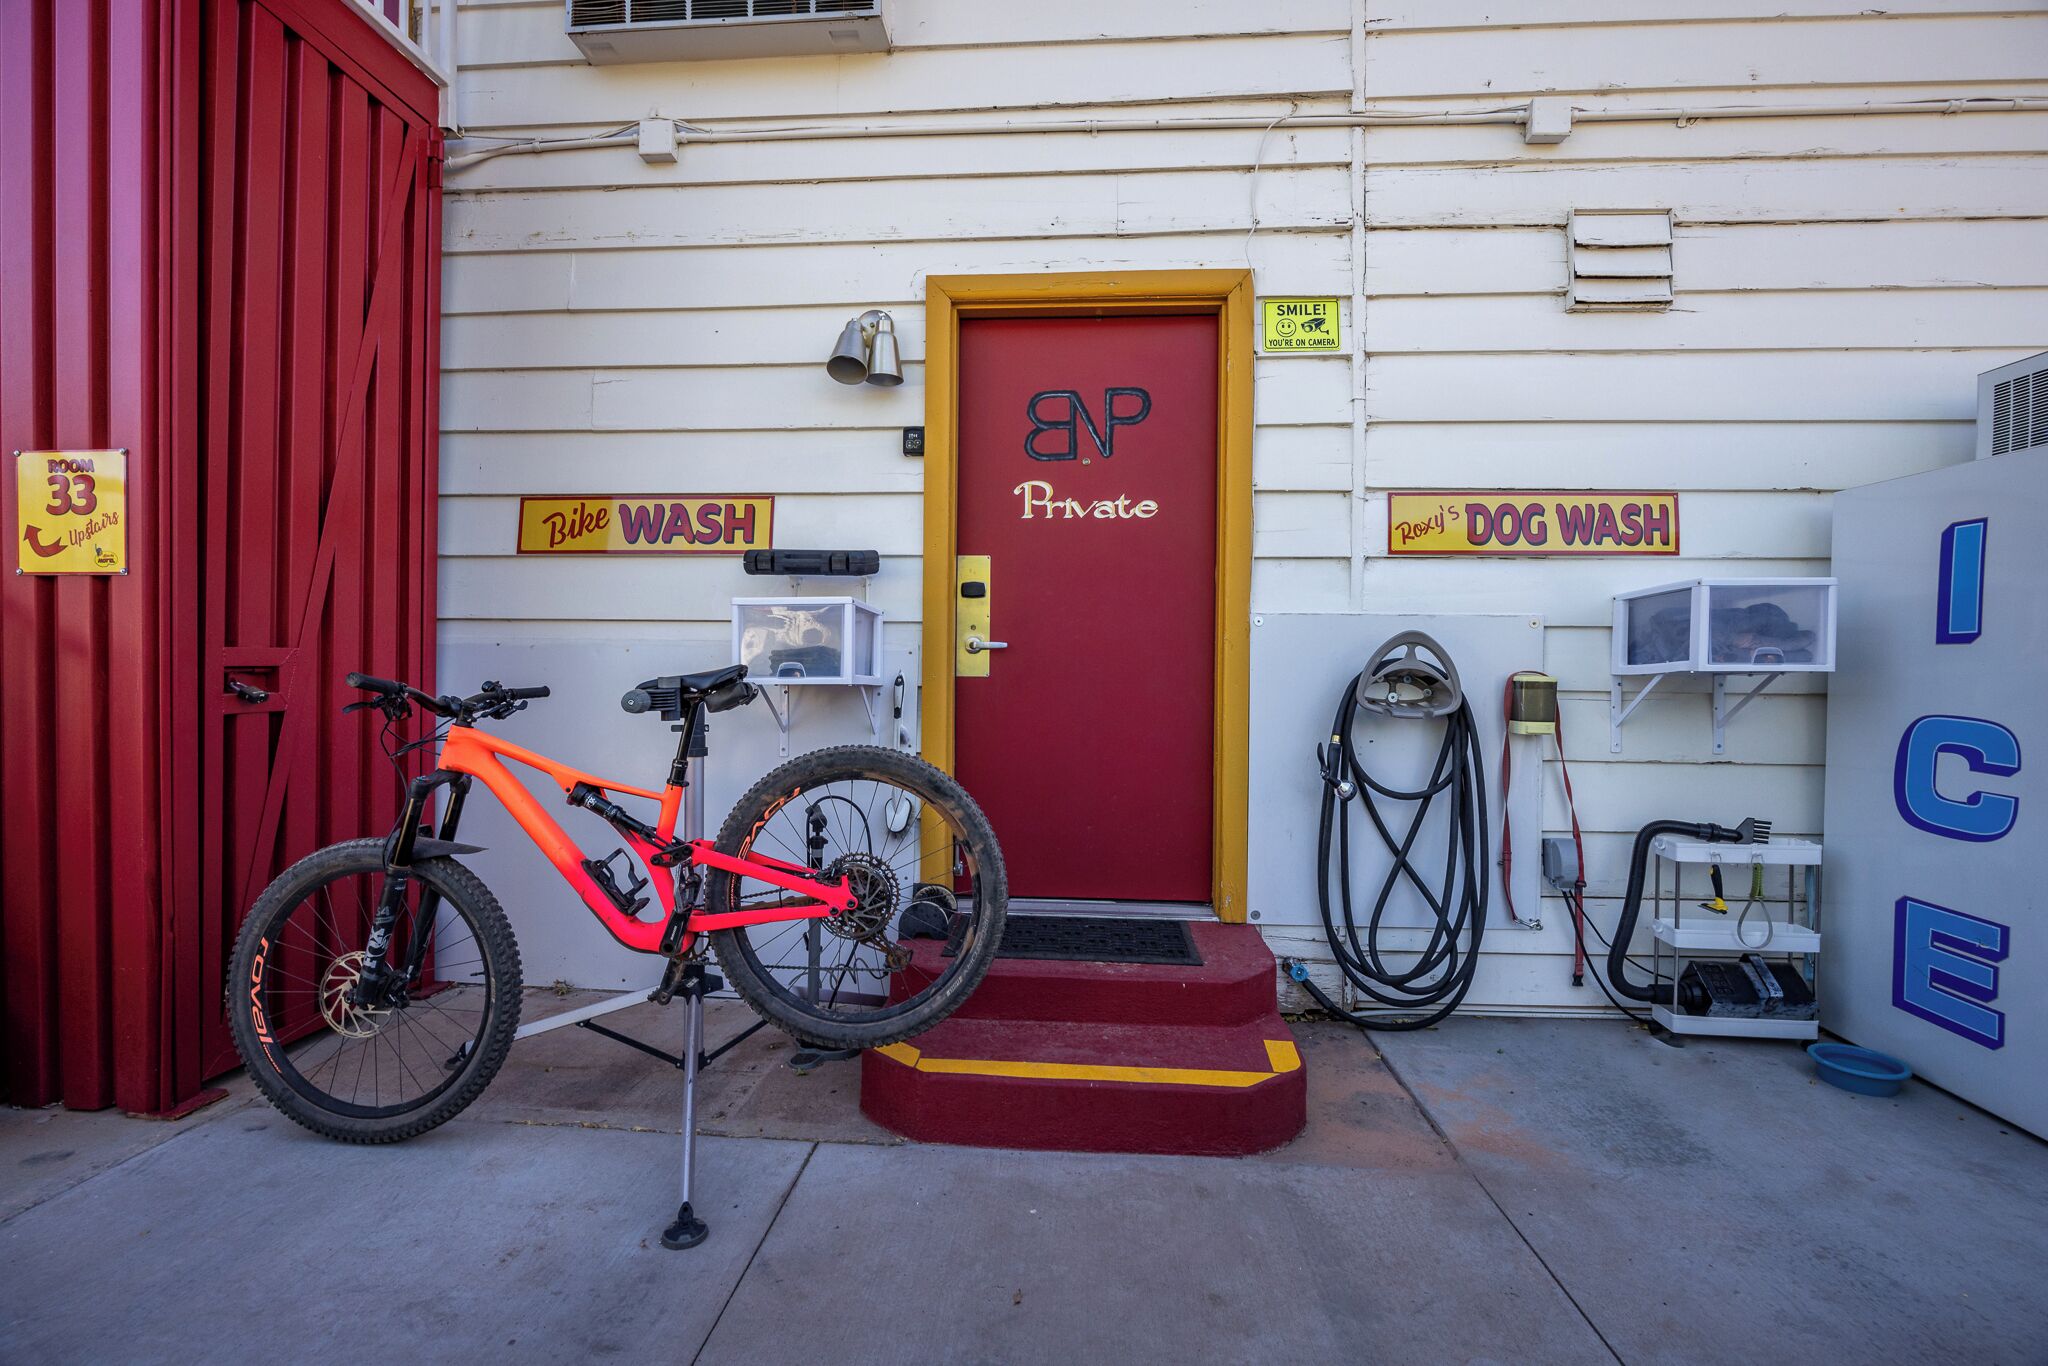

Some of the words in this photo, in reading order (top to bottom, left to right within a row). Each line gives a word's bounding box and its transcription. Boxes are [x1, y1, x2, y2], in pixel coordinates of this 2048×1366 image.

[1277, 304, 1326, 316] SMILE!
[1269, 338, 1293, 346] YOU'RE
[1295, 338, 1306, 346] ON
[1308, 338, 1335, 346] CAMERA
[47, 459, 95, 473] ROOM
[46, 474, 97, 516] 33
[1013, 480, 1159, 519] Private
[69, 512, 119, 547] Upstairs
[542, 502, 610, 548] Bike
[618, 503, 755, 545] WASH
[1395, 504, 1460, 545] Roxy's
[1465, 503, 1548, 546] DOG
[1555, 503, 1670, 546] WASH
[1892, 517, 2022, 1051] ICE
